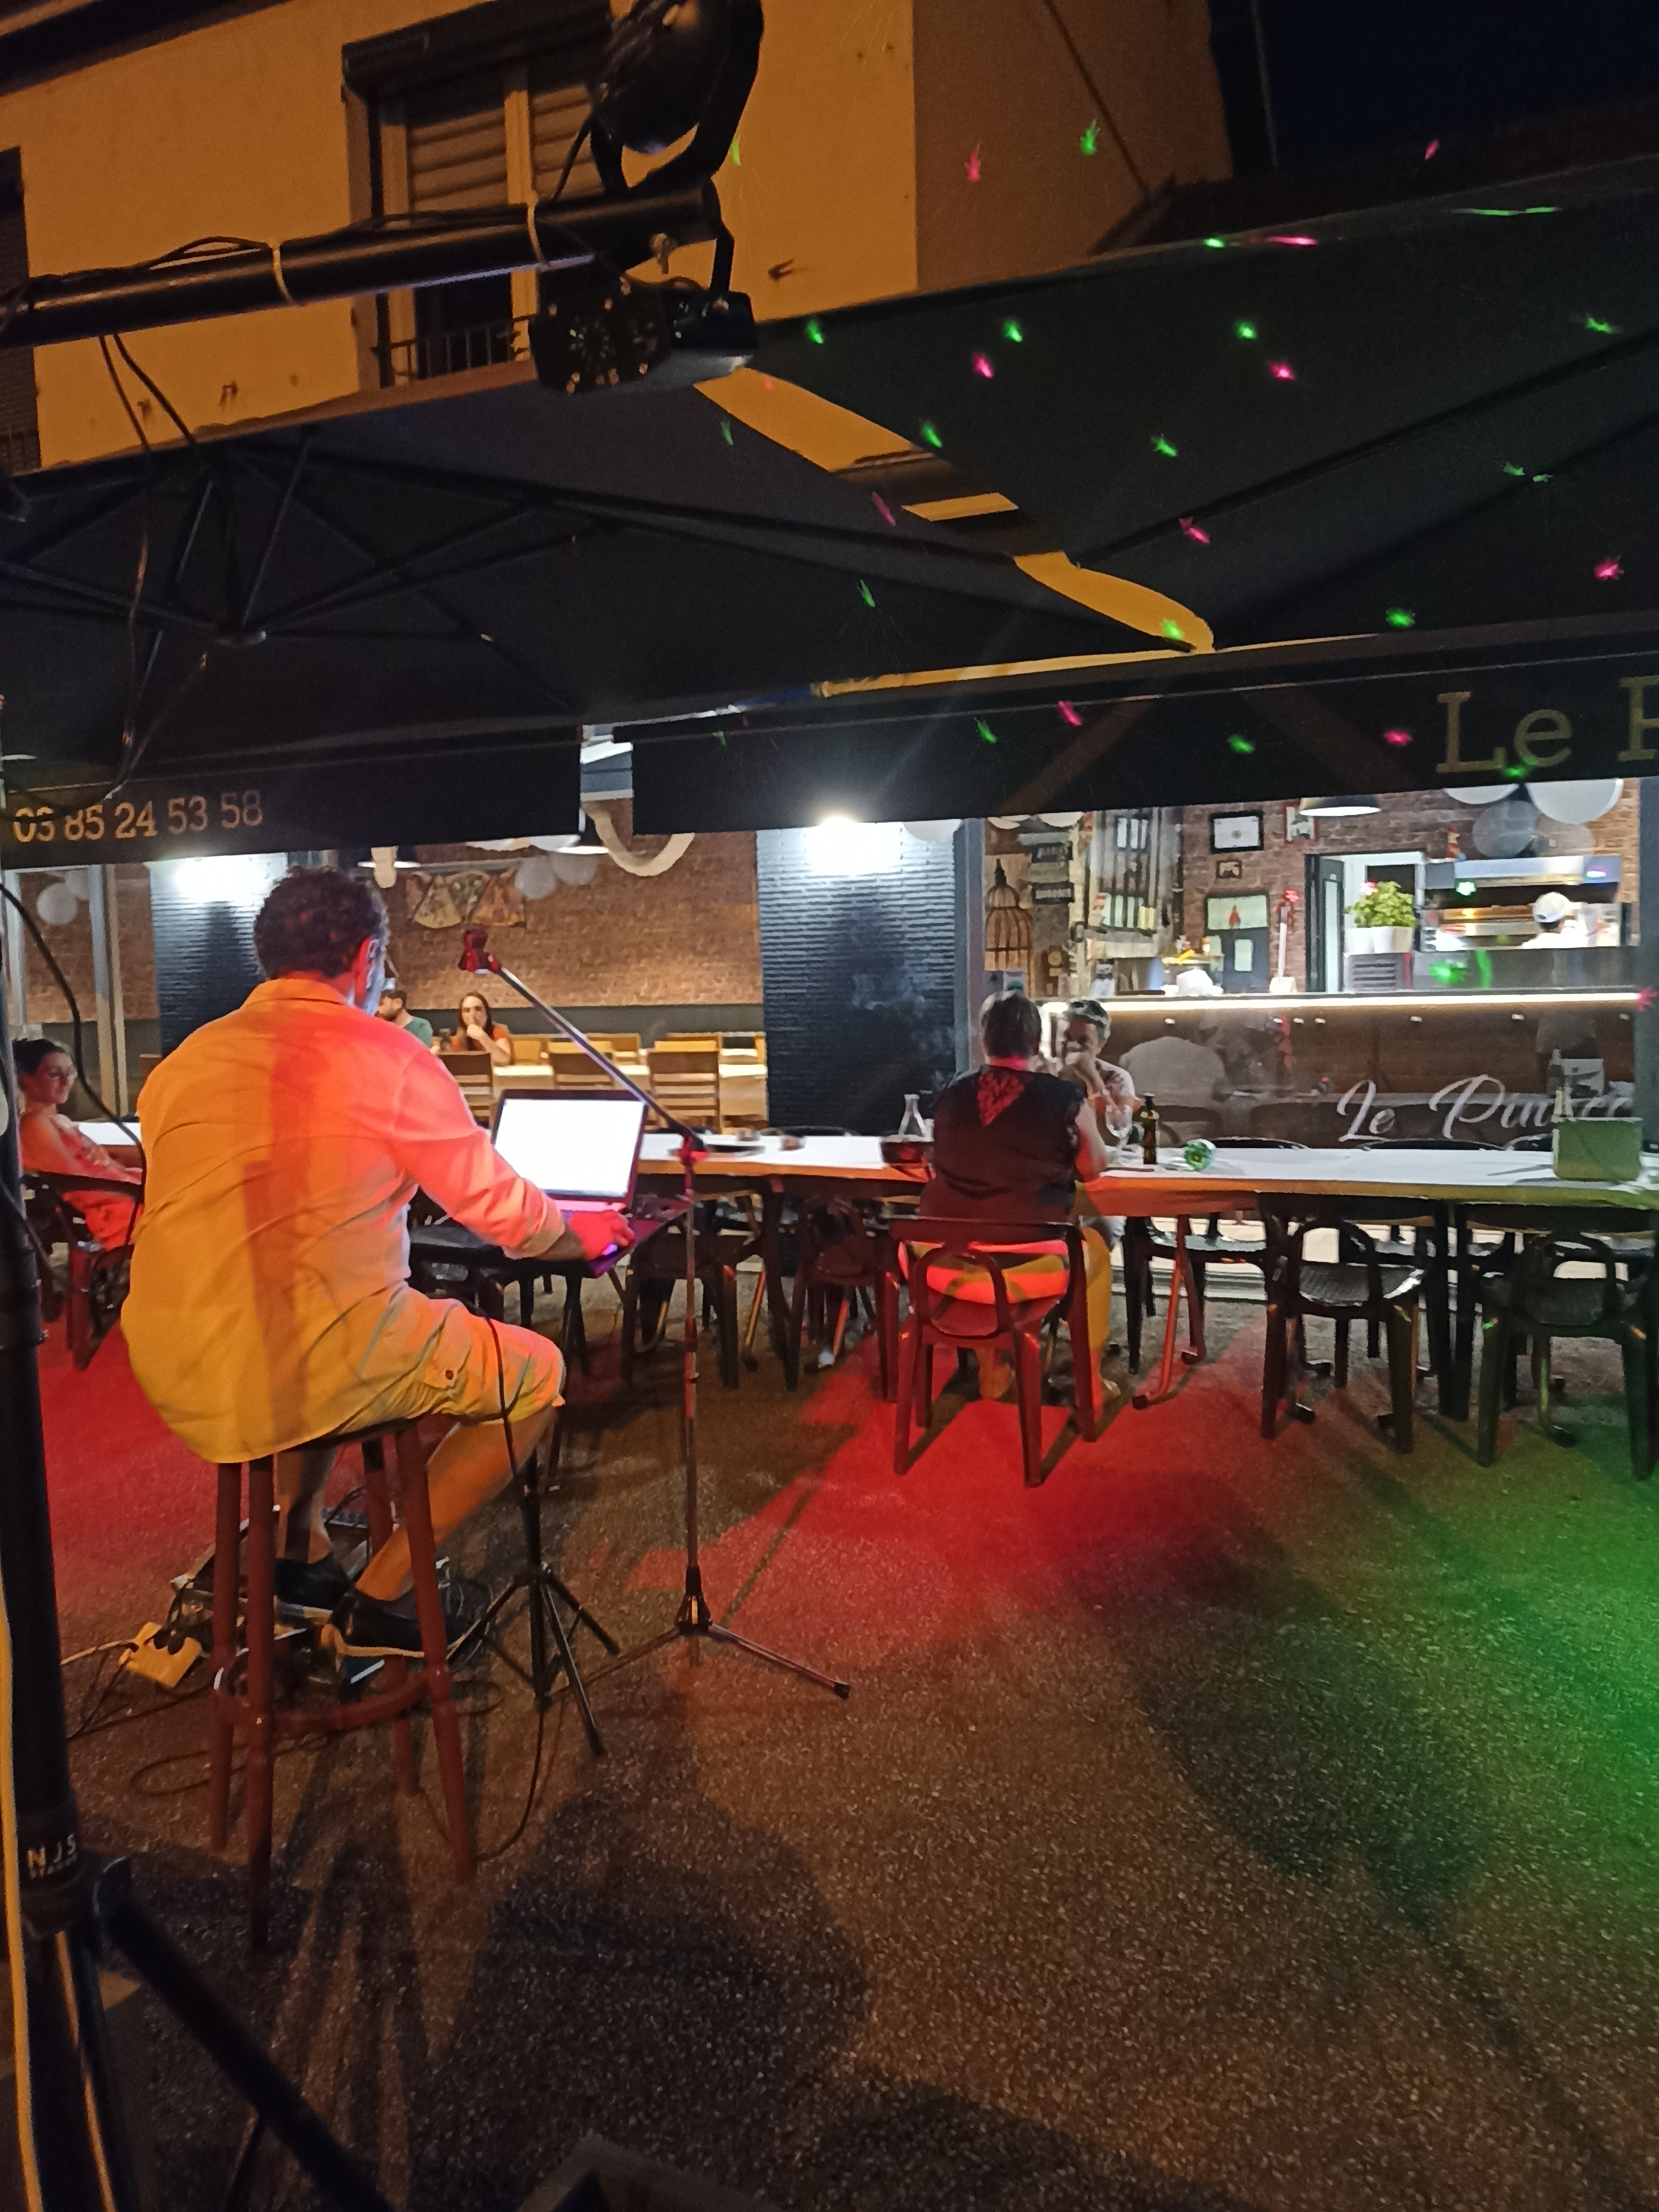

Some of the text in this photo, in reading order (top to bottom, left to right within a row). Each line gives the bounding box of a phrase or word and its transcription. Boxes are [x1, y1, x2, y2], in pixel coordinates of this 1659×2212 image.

[1436, 691, 1572, 773] Le
[64, 804, 105, 840] 85
[114, 801, 158, 839] 24
[167, 795, 208, 835] 53
[220, 789, 264, 829] 58
[1336, 1080, 1395, 1143] Le
